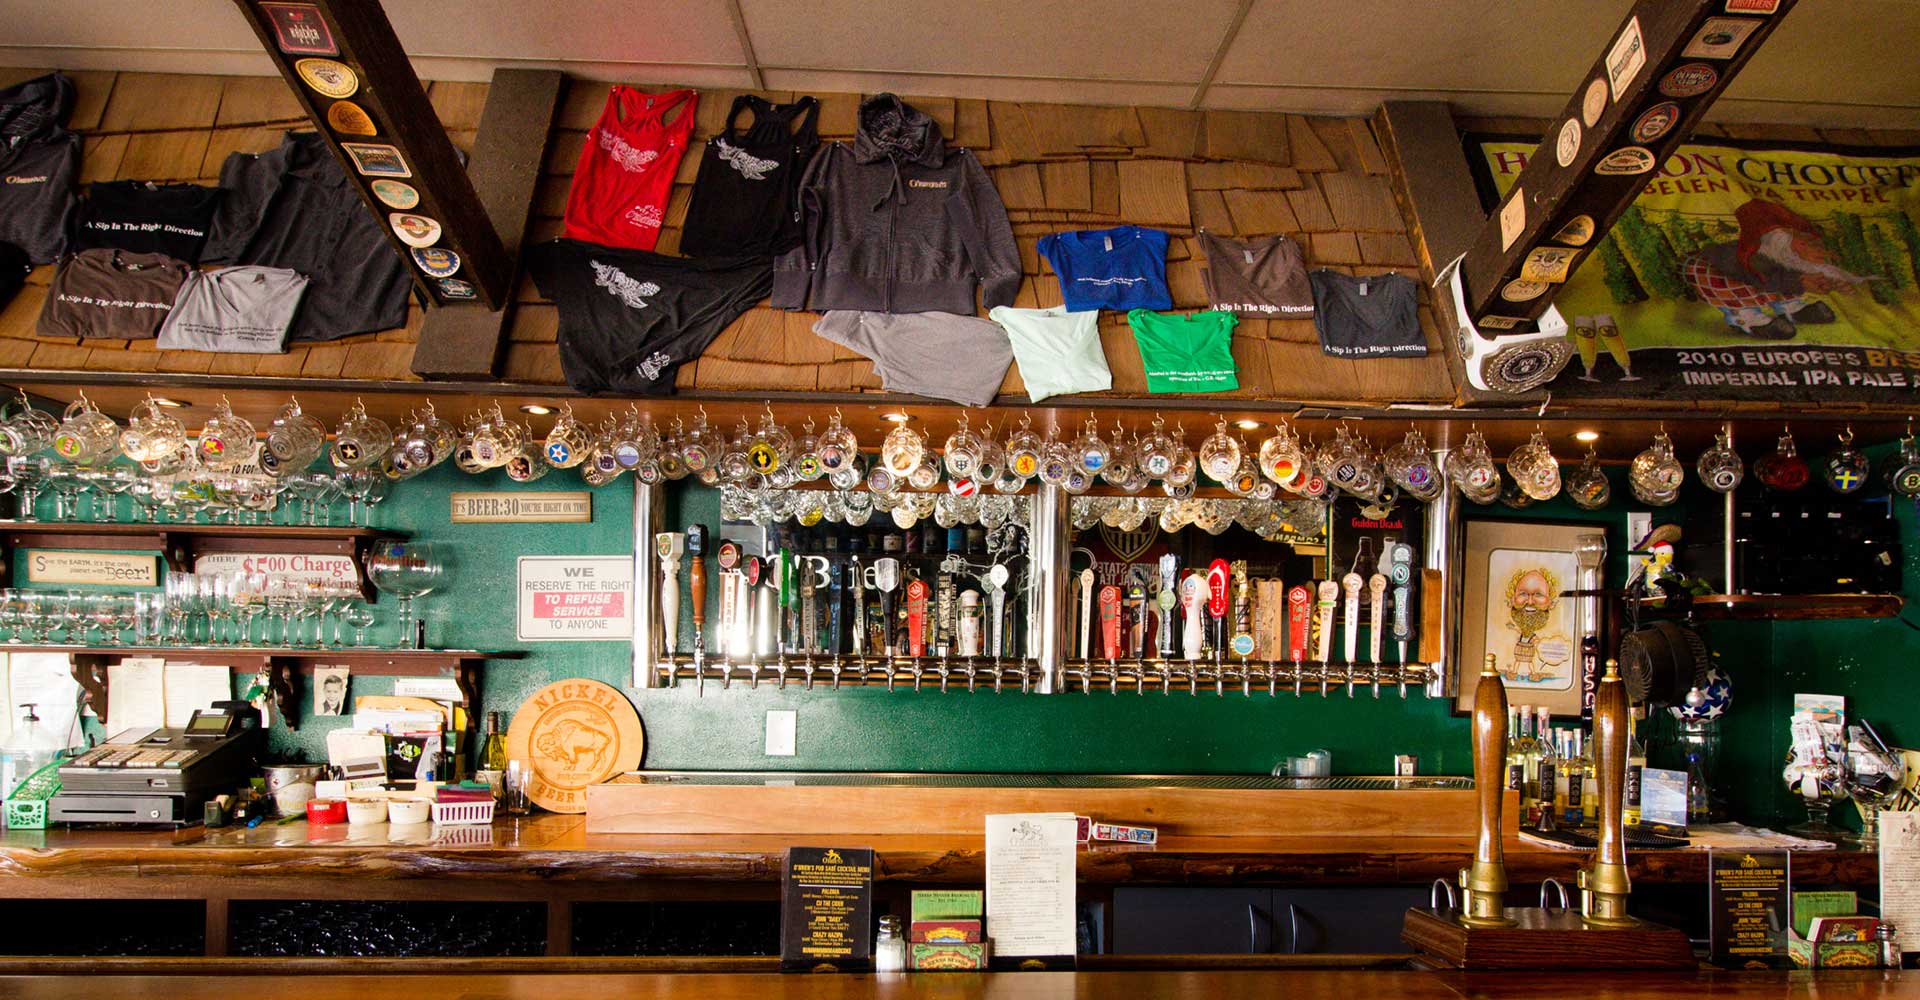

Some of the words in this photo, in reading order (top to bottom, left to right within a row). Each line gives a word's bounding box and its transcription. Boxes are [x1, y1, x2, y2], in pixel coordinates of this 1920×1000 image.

[1736, 157, 1920, 188] CHOUFF
[1644, 178, 1731, 197] BELEN
[1788, 187, 1892, 204] TRIPEL
[86, 220, 94, 228] A
[95, 221, 110, 231] Sip
[111, 222, 121, 230] In
[123, 222, 140, 231] The
[164, 224, 204, 237] Direction
[57, 293, 66, 301] A
[95, 298, 110, 307] The
[1212, 303, 1219, 312] A
[1219, 303, 1233, 313] Sip
[1243, 303, 1258, 312] The
[1332, 346, 1345, 355] Sip
[1353, 346, 1368, 354] The
[1393, 344, 1427, 352] Direction
[1678, 351, 1736, 367] 2010
[1741, 351, 1862, 366] EUROPE'S
[1865, 350, 1920, 368] BES
[1682, 371, 1797, 387] IMPERIAL
[1802, 370, 1842, 386] IPA
[1847, 371, 1907, 387] PALE
[452, 503, 466, 513] IT'S
[468, 498, 519, 516] BEER:30
[521, 502, 543, 513] YOU'RE
[543, 502, 561, 513] RIGHT
[563, 502, 572, 513] ON
[573, 502, 587, 513] TIME
[104, 566, 150, 580] Beer!
[290, 556, 351, 577] Charge
[563, 567, 594, 577] WE
[525, 580, 572, 591] RESERVE
[578, 580, 596, 591] THE
[601, 580, 631, 591] RIGHT
[544, 594, 561, 605] TO
[565, 593, 612, 605] REFUSE
[553, 606, 602, 617] SERVICE
[549, 619, 563, 630] TO
[567, 619, 608, 630] ANYONE
[533, 684, 618, 712] NICKEL
[536, 784, 575, 803] BEER
